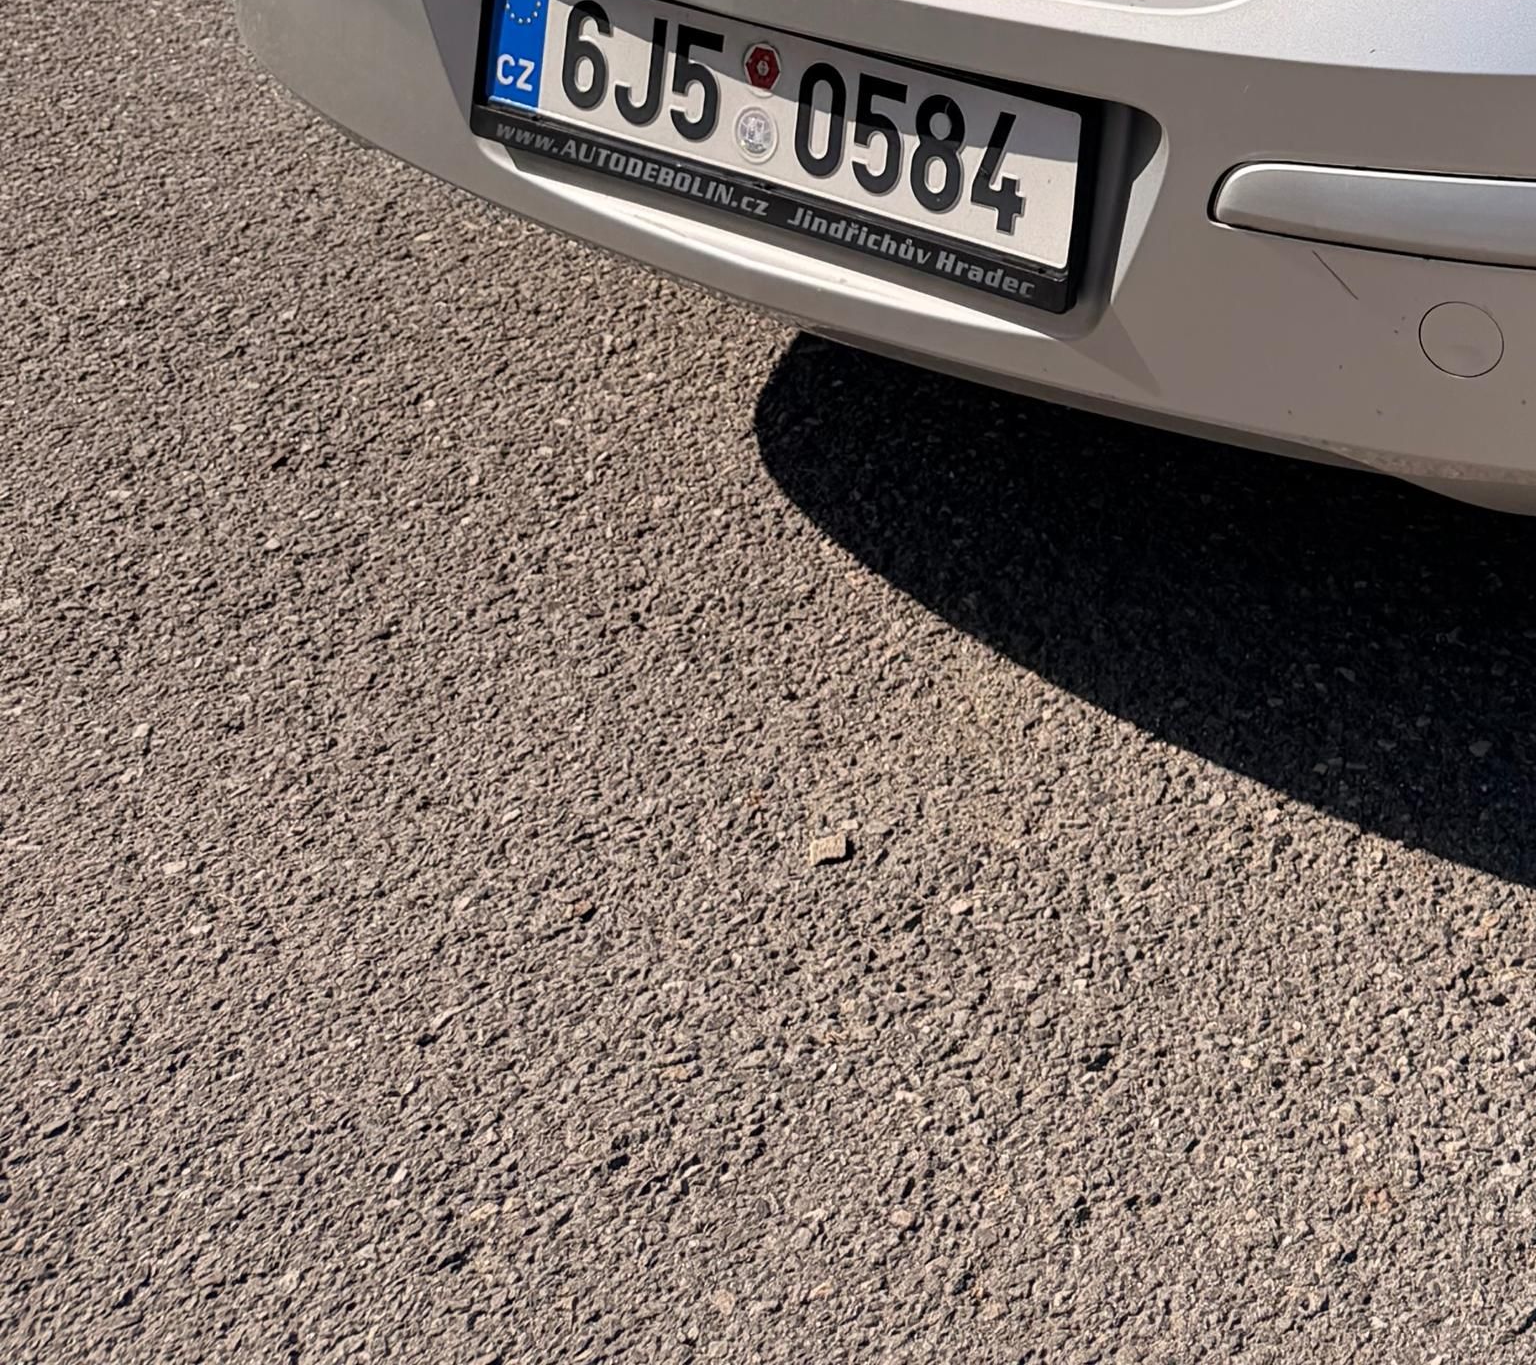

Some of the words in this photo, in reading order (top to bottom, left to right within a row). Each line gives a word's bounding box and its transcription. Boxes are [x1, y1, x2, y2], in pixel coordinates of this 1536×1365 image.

[496, 53, 535, 93] CZ
[560, 0, 727, 143] 6J5
[794, 61, 1027, 237] 0584
[496, 122, 770, 217] www.AUTODEBOLIN.cz
[787, 206, 932, 266] Jindřichův
[935, 250, 1036, 299] Hradec
